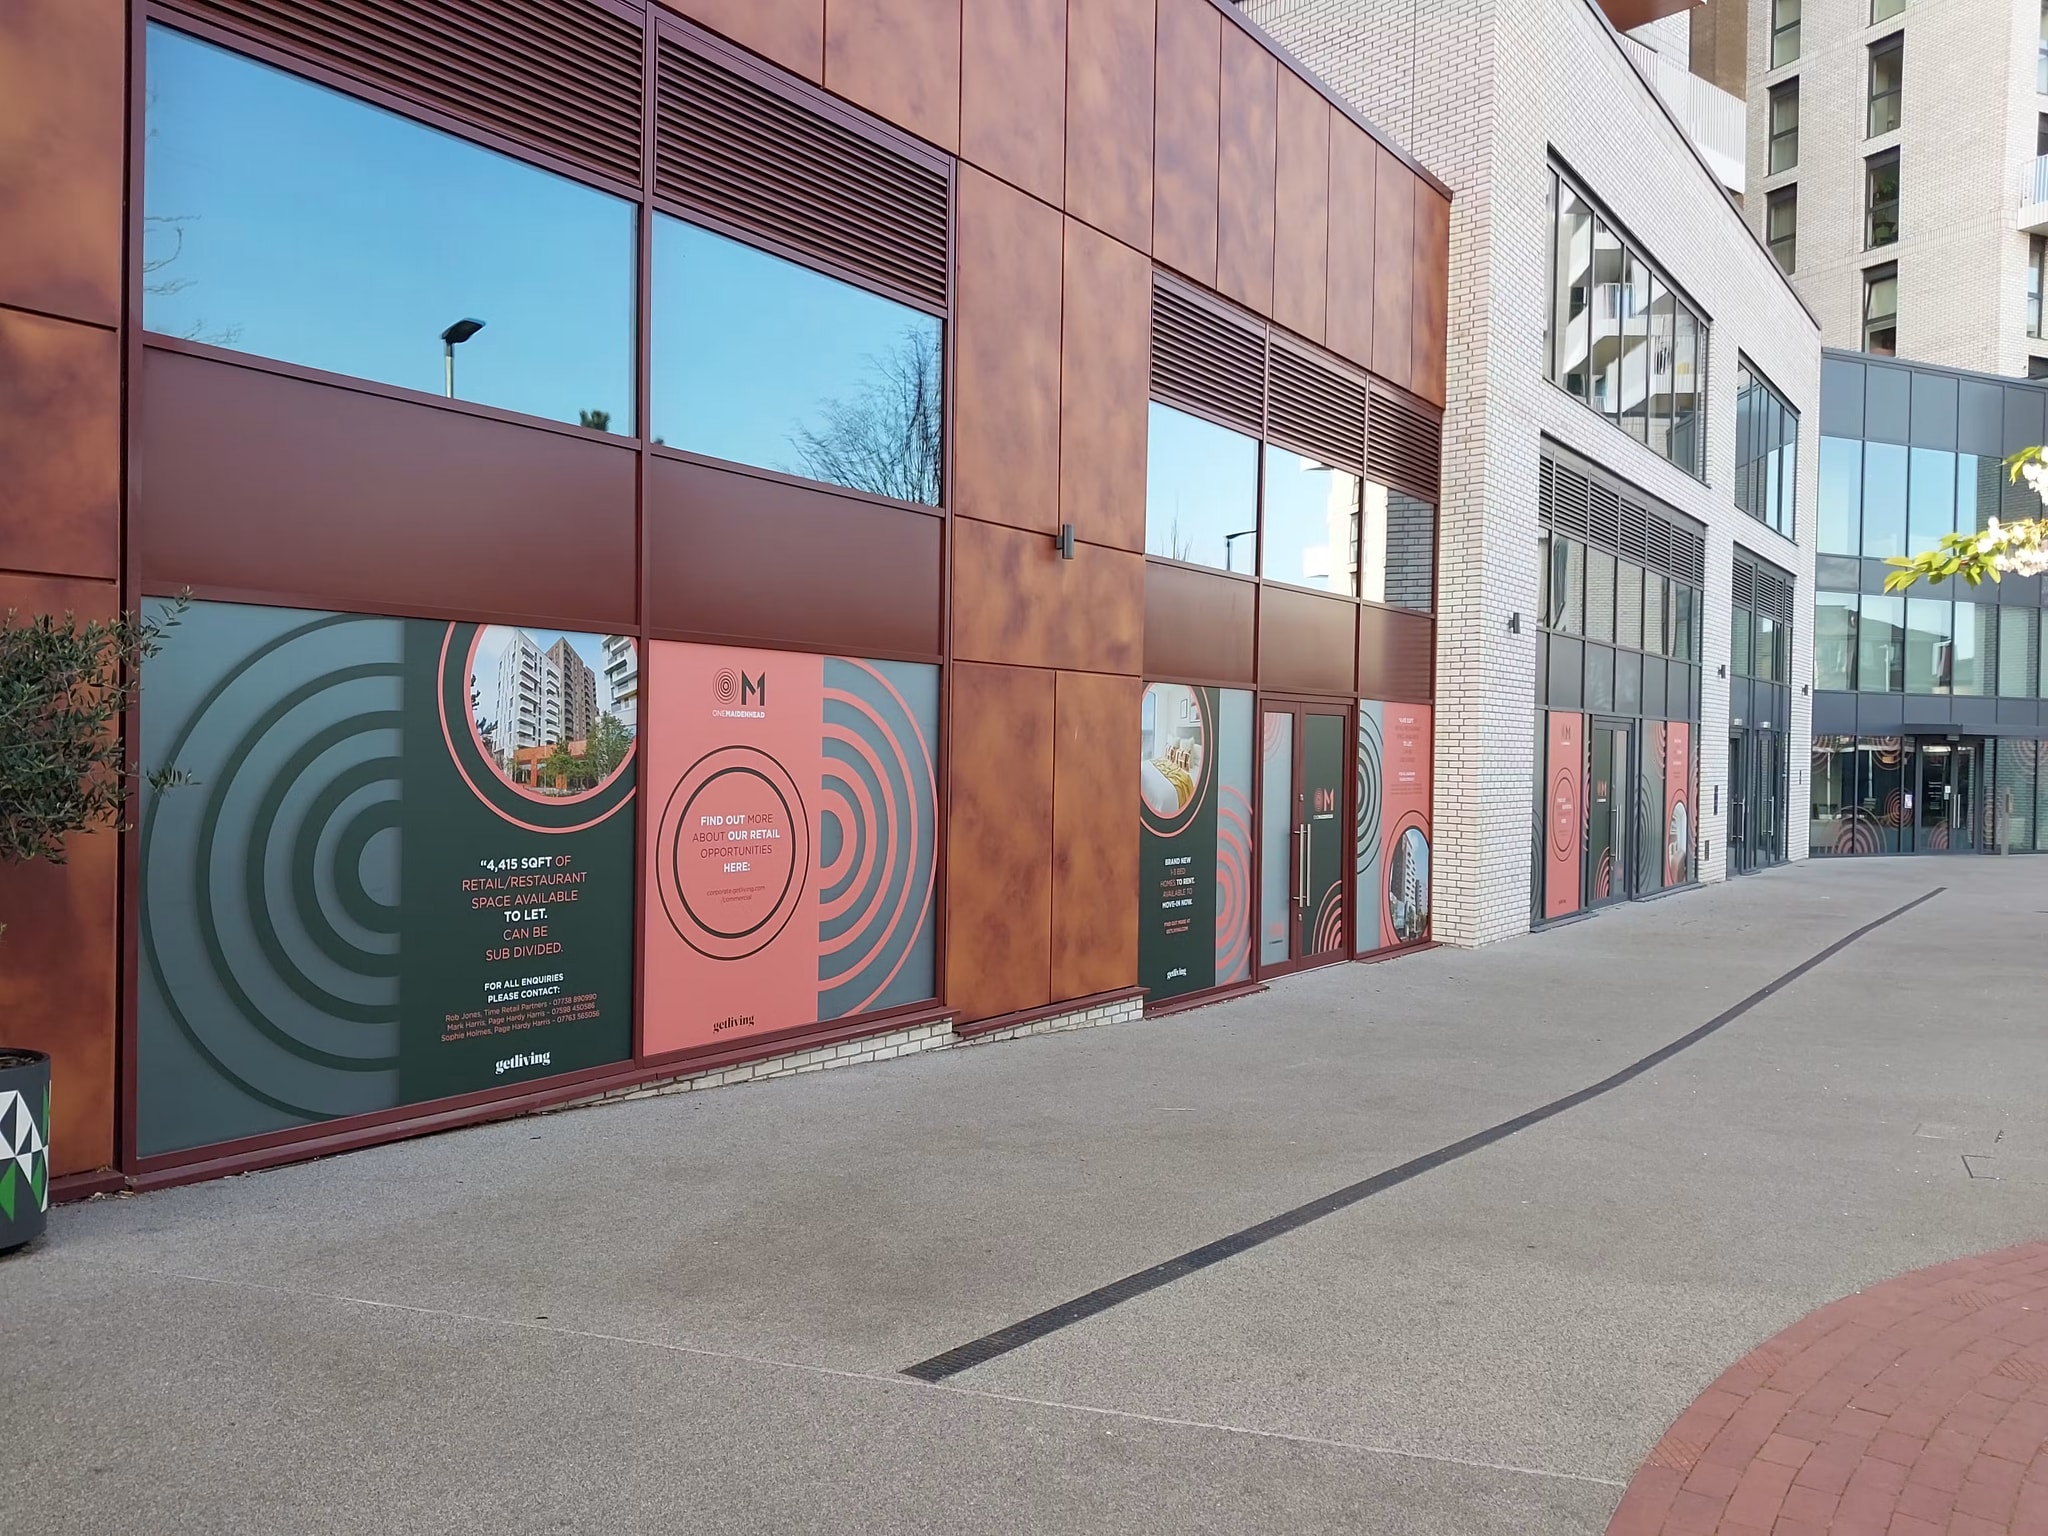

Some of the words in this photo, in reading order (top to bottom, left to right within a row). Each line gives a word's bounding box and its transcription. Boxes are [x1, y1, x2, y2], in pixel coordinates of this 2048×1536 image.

[700, 815, 724, 826] FIND
[725, 814, 746, 825] OUT
[747, 813, 774, 824] MORE
[692, 831, 726, 843] ABOUT
[727, 830, 748, 841] OUR
[750, 829, 781, 840] RETAIL
[700, 844, 773, 859] OPPORTUNITIES
[520, 856, 553, 870] SQFT
[555, 855, 572, 867] OF
[723, 862, 751, 873] HERE:
[462, 871, 588, 892] RETAIL/RESTAURANT
[1176, 878, 1183, 886] TO
[471, 895, 512, 910] SPACE
[514, 889, 579, 906] AVAILABLE
[504, 910, 521, 922] TO
[524, 908, 548, 921] LET.
[503, 927, 530, 941] CAN
[532, 926, 548, 938] BE
[485, 947, 511, 962] SUB
[513, 942, 564, 958] DIVIDED.
[484, 981, 502, 992] FOR
[503, 978, 520, 989] ALL
[521, 973, 564, 987] ENQUIRIES
[487, 989, 519, 1004] PLEASE
[520, 986, 561, 999] CONTACT:
[445, 1013, 460, 1022] Rob
[484, 1008, 500, 1017] Time
[501, 1004, 520, 1014] Retail
[521, 1001, 548, 1010] Partners
[441, 1032, 465, 1042] Sophie
[494, 1025, 511, 1034] Page
[511, 1021, 532, 1031] Hardy
[532, 1018, 551, 1027] Harris
[446, 1022, 464, 1032] Mark
[488, 1017, 505, 1026] Page
[506, 1013, 526, 1023] Hardy
[526, 1010, 546, 1019] Harris
[713, 1014, 755, 1034] getliving
[494, 1051, 551, 1075] getliving
